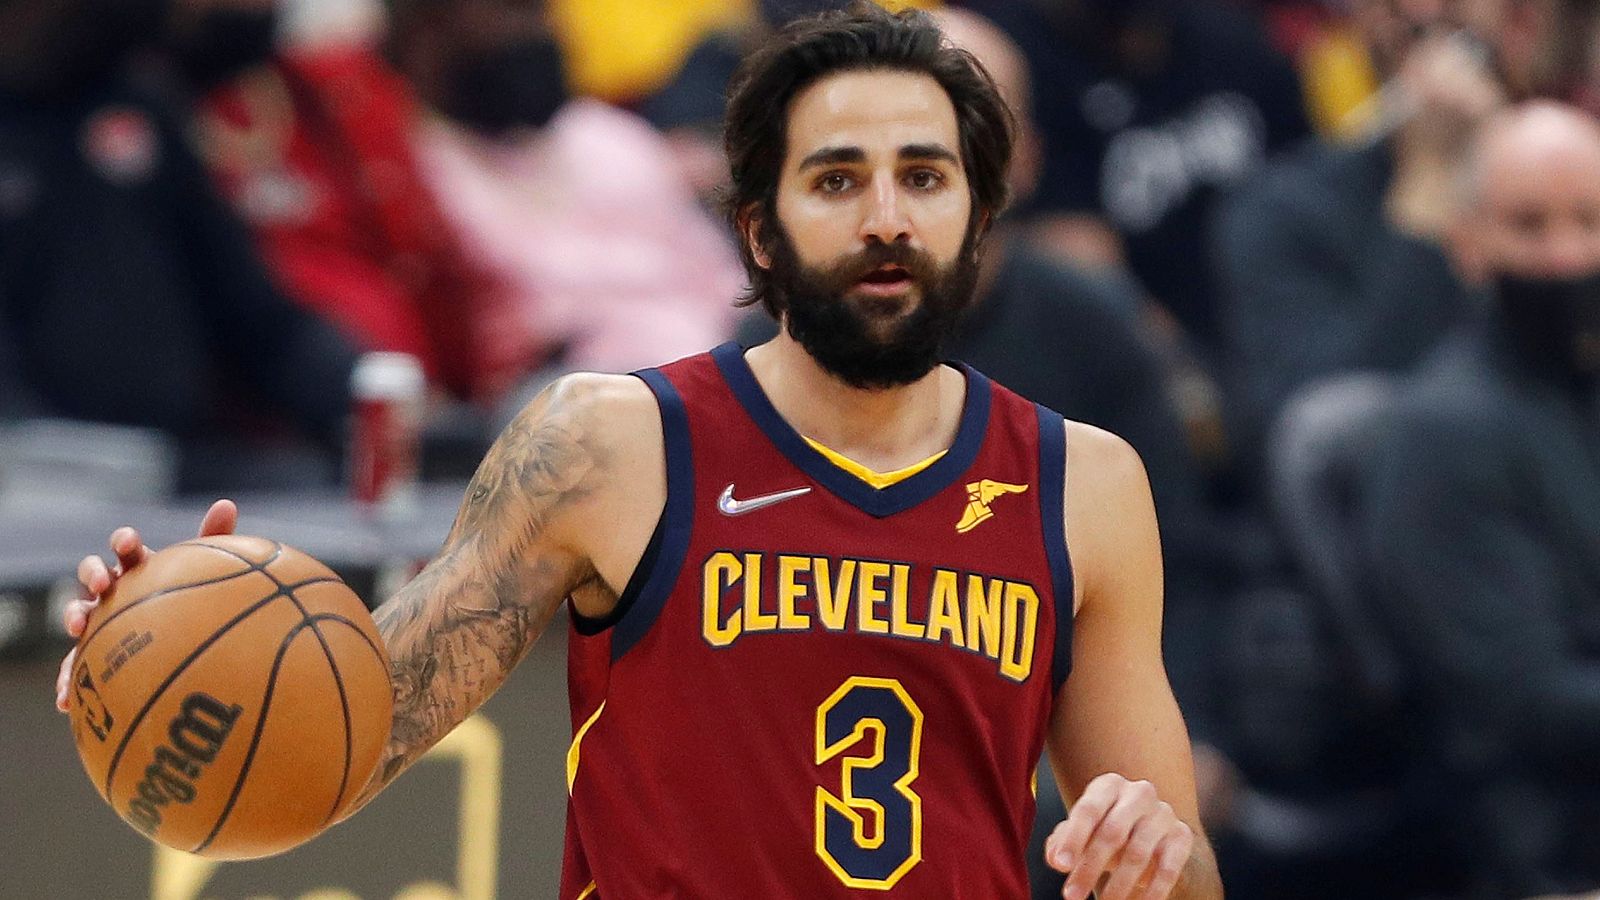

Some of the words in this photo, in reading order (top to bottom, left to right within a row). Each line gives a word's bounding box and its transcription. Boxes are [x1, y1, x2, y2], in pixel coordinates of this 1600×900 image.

[701, 550, 1040, 684] CLEVELAND
[127, 691, 244, 833] Wilso
[815, 676, 924, 890] 3
